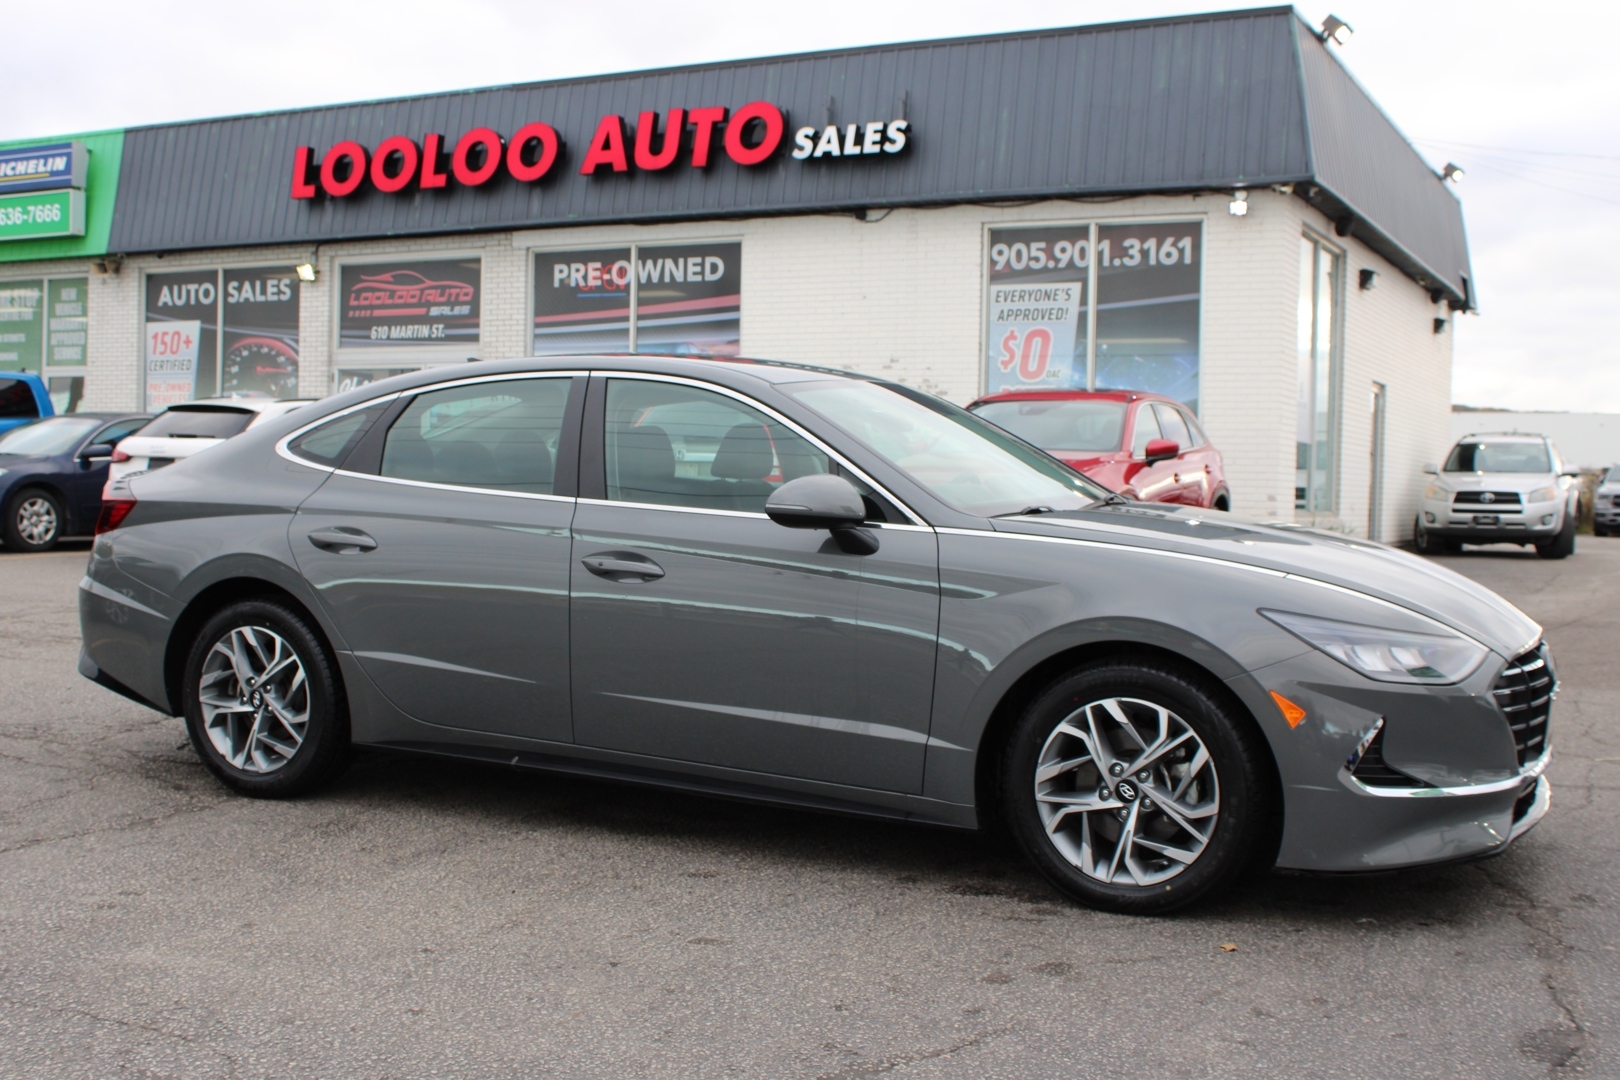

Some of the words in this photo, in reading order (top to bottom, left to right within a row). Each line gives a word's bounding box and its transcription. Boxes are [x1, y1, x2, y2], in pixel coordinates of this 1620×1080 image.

[291, 121, 558, 199] LOOLOO
[579, 101, 783, 176] AUTO
[792, 120, 908, 160] SALES
[991, 236, 1192, 271] 905.901.3161
[553, 256, 725, 287] PRE-OWNED
[157, 282, 216, 307] AUTO
[227, 279, 291, 303] SALES
[349, 289, 421, 306] LOOLOO
[421, 288, 474, 303] AUTO
[995, 287, 1072, 303] EVERYONE'S
[429, 305, 471, 316] SALES
[996, 307, 1069, 322] APPROVED!
[370, 325, 388, 340] 610
[390, 324, 430, 339] MARTIN
[431, 324, 445, 338] ST.
[151, 331, 193, 356] 150+
[1000, 328, 1052, 381] $0
[148, 359, 192, 372] CERTIFIED
